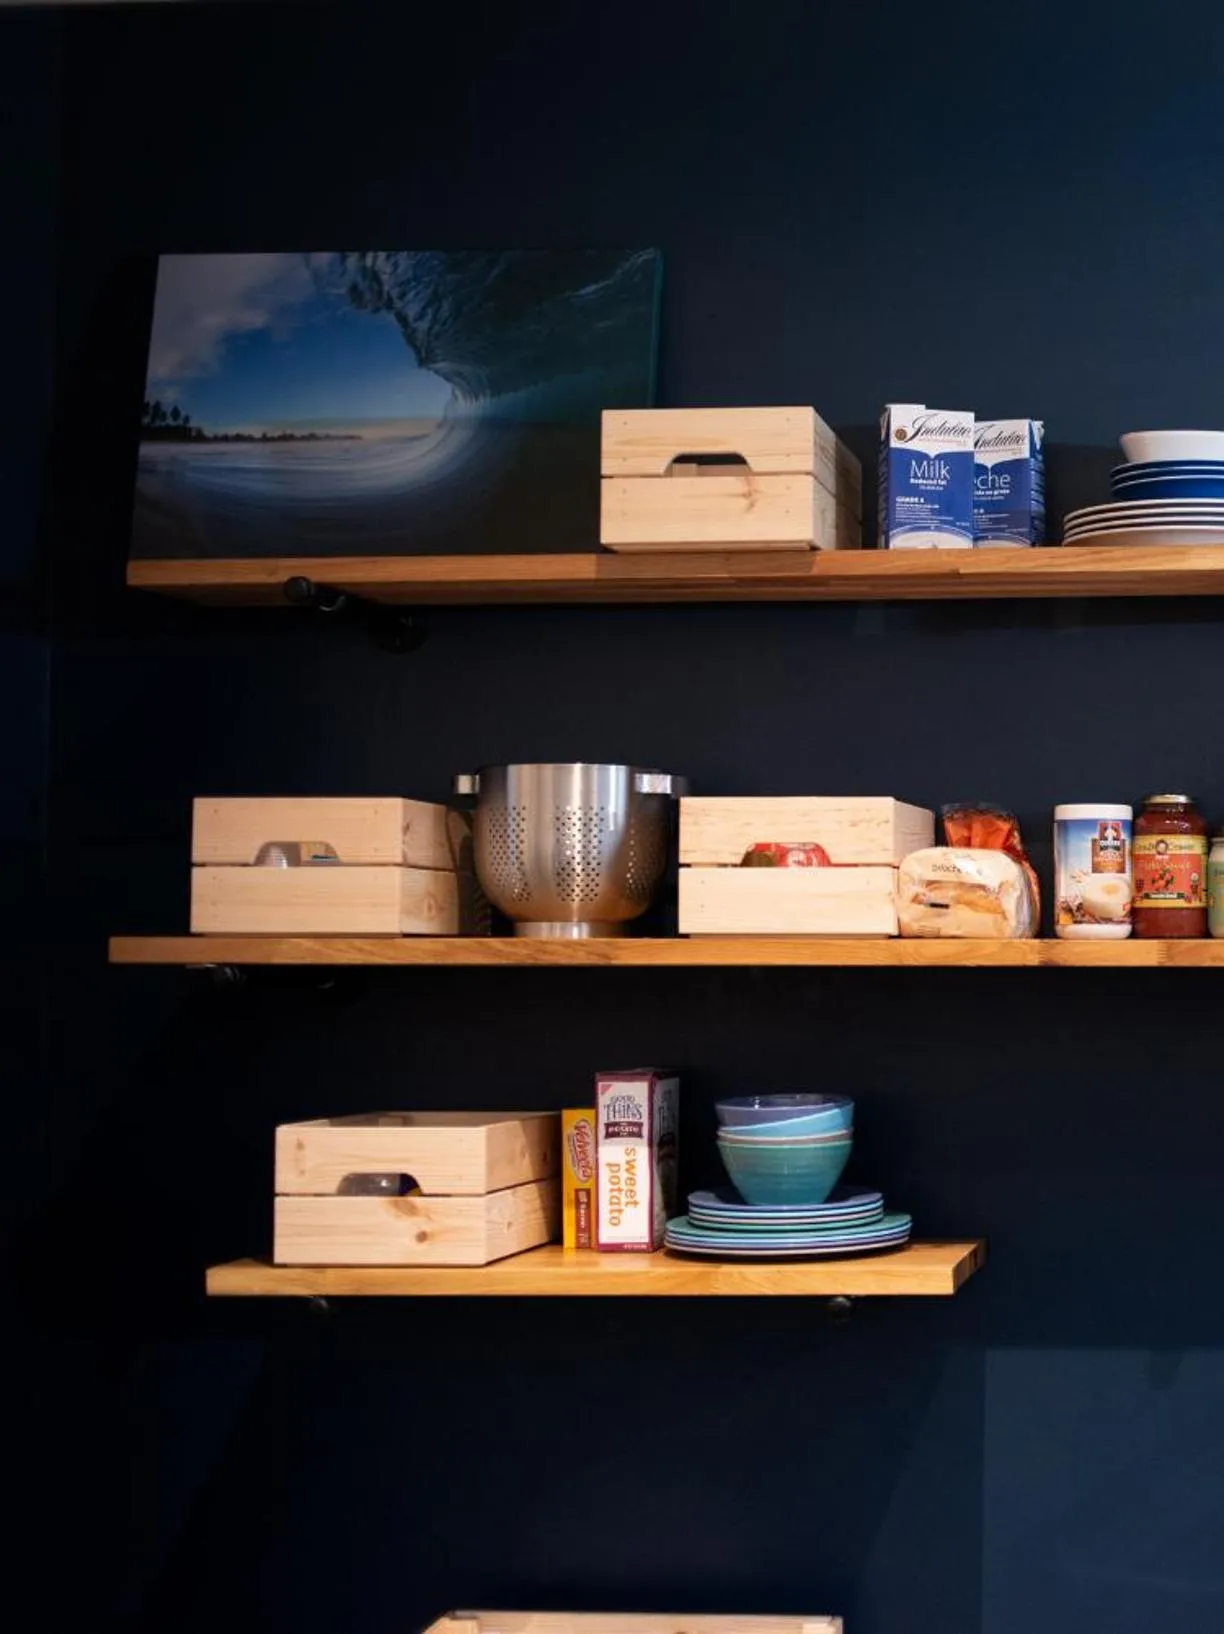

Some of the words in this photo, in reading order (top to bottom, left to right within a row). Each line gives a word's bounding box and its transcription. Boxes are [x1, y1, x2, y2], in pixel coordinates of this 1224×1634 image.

[909, 459, 950, 480] Milk
[974, 469, 1011, 489] che
[604, 1102, 642, 1120] THINS
[625, 1147, 640, 1208] sweet
[606, 1163, 624, 1227] potato
